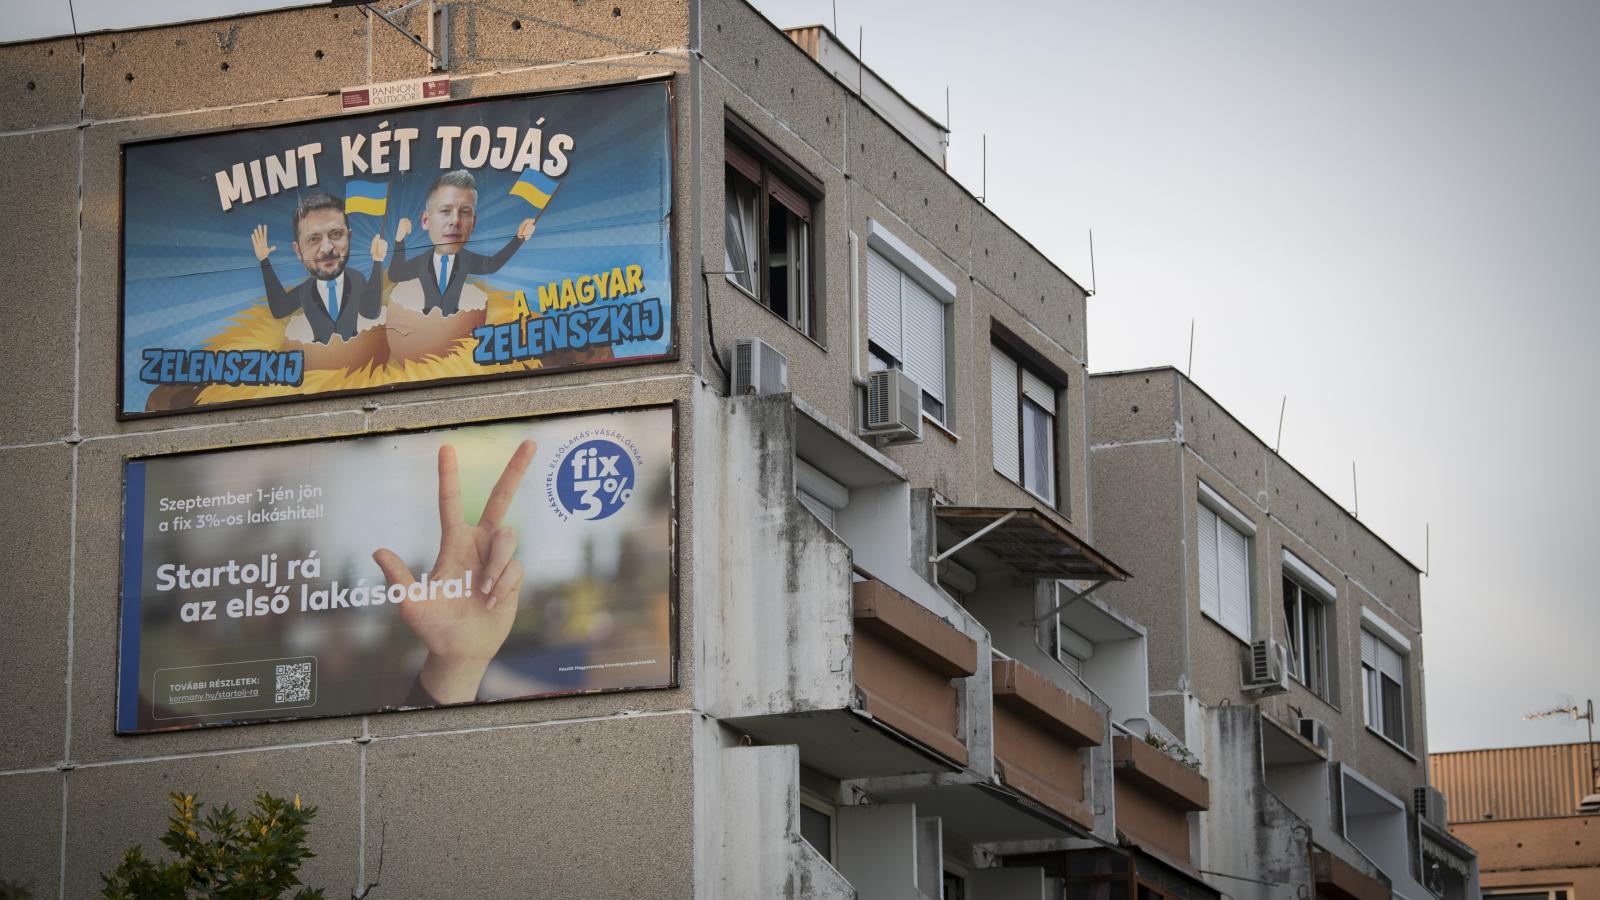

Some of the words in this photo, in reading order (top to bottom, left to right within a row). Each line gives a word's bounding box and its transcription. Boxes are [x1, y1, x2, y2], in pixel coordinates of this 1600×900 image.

[372, 83, 416, 97] PANNON
[372, 93, 416, 106] OUTDOOR
[214, 142, 322, 212] MINT
[340, 120, 419, 177] KÉT
[436, 116, 574, 177] TOJÁS
[511, 290, 530, 321] A
[538, 264, 645, 312] MAGYAR
[473, 298, 663, 364] ZELENSZKIJ
[140, 349, 304, 386] ZELENSZKIJ
[571, 447, 621, 480] fix
[159, 490, 253, 513] Szeptember
[256, 486, 294, 503] 1-jén
[297, 484, 323, 501] jön
[573, 477, 633, 521] 3%
[158, 520, 169, 532] a
[172, 516, 192, 531] fix
[195, 513, 244, 529] 3%-os
[247, 504, 324, 524] lakáshitel!
[156, 553, 278, 592] Startolj
[287, 550, 321, 580] rá
[180, 600, 217, 623] az
[226, 584, 290, 618] első
[300, 570, 473, 612] lakásodra!
[169, 680, 207, 692] TOVÁBBI
[209, 677, 260, 689] RÉSZLETEK:
